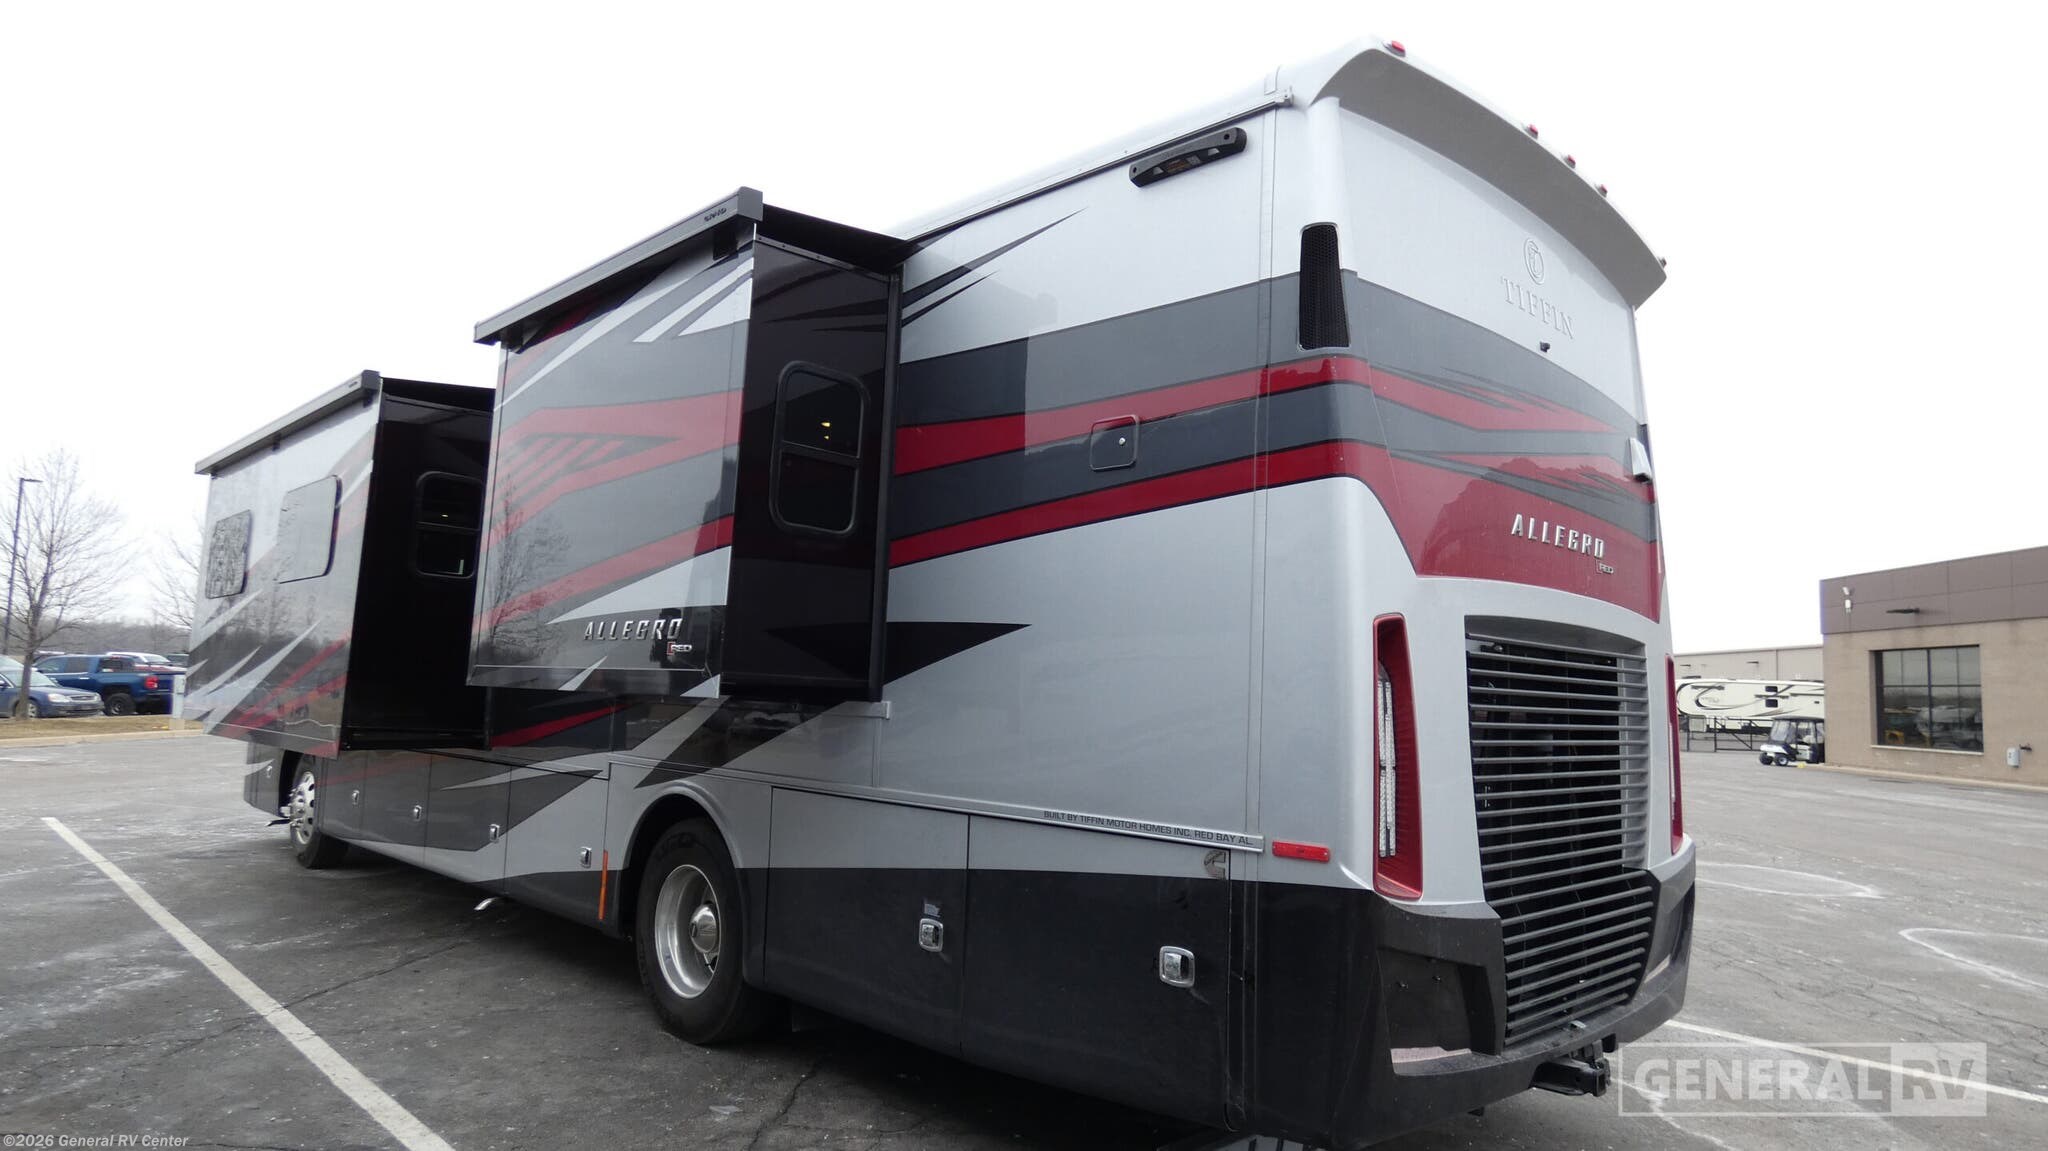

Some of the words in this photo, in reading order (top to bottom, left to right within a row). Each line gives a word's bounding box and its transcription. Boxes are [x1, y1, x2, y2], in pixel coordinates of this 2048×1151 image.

[1501, 276, 1574, 339] TIFFIN
[1511, 513, 1604, 559] ALLEGRO
[584, 618, 683, 640] ALLEGRO
[1043, 810, 1065, 821] BUILT
[1067, 813, 1079, 822] BY
[1080, 815, 1105, 826] TIFFIN
[1106, 819, 1138, 830] MOTOR
[1139, 824, 1172, 835] HOMES
[1194, 831, 1214, 841] RED
[1215, 833, 1237, 843] BAY
